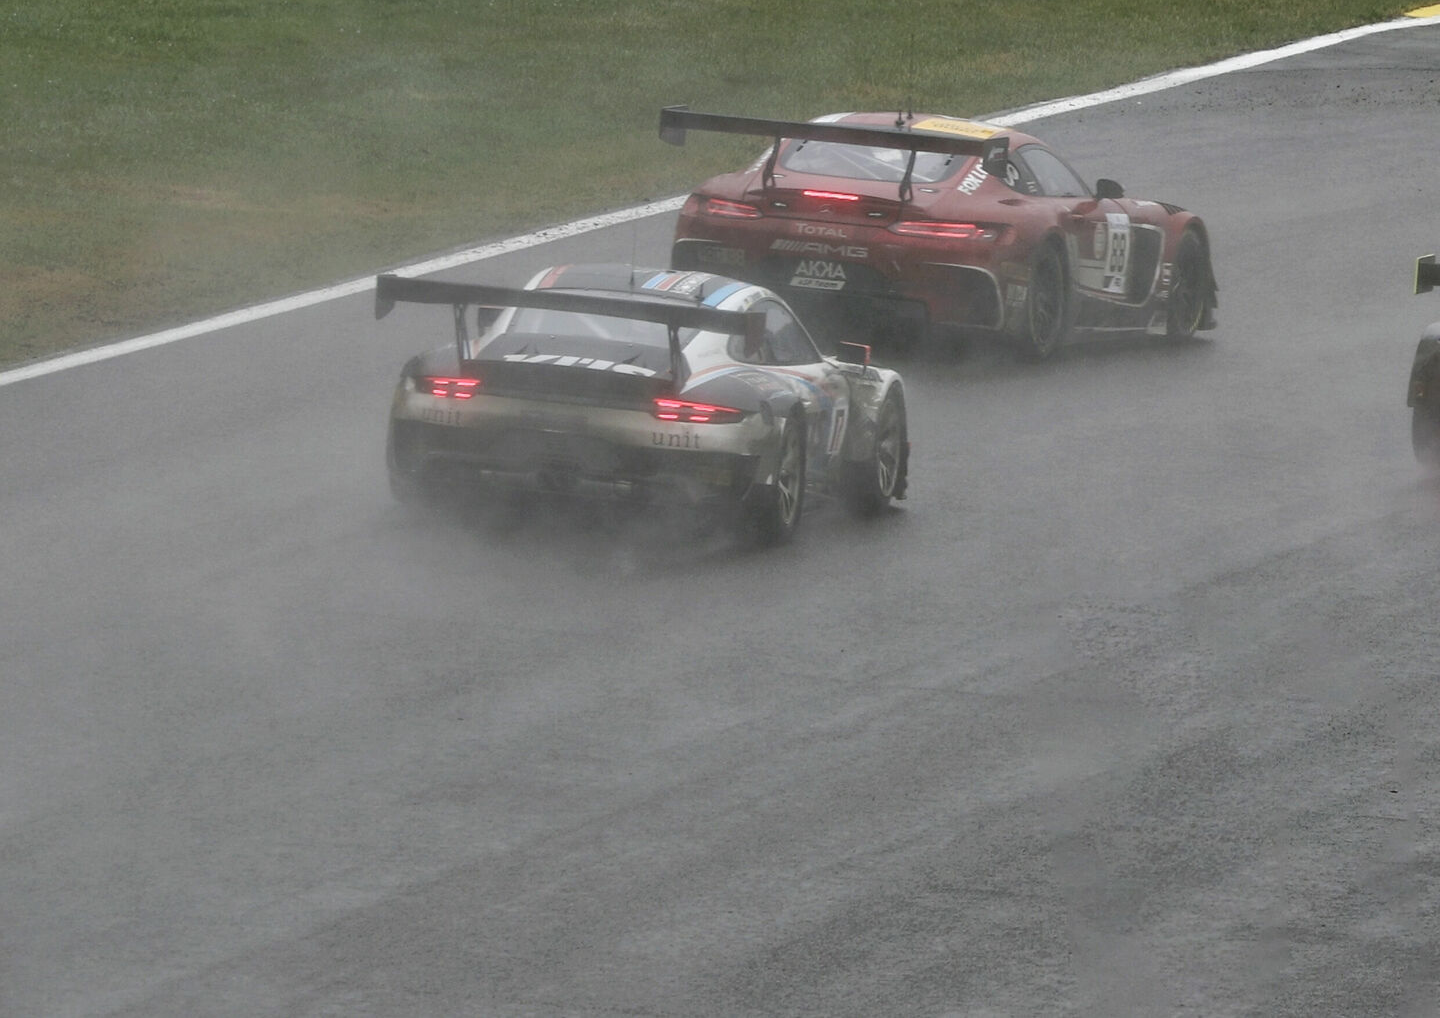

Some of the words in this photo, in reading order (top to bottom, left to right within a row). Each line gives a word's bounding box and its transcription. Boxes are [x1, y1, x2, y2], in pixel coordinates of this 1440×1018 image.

[800, 241, 870, 259] AMG
[795, 259, 848, 280] AKKA
[420, 405, 463, 428] unit
[651, 428, 701, 449] unit
